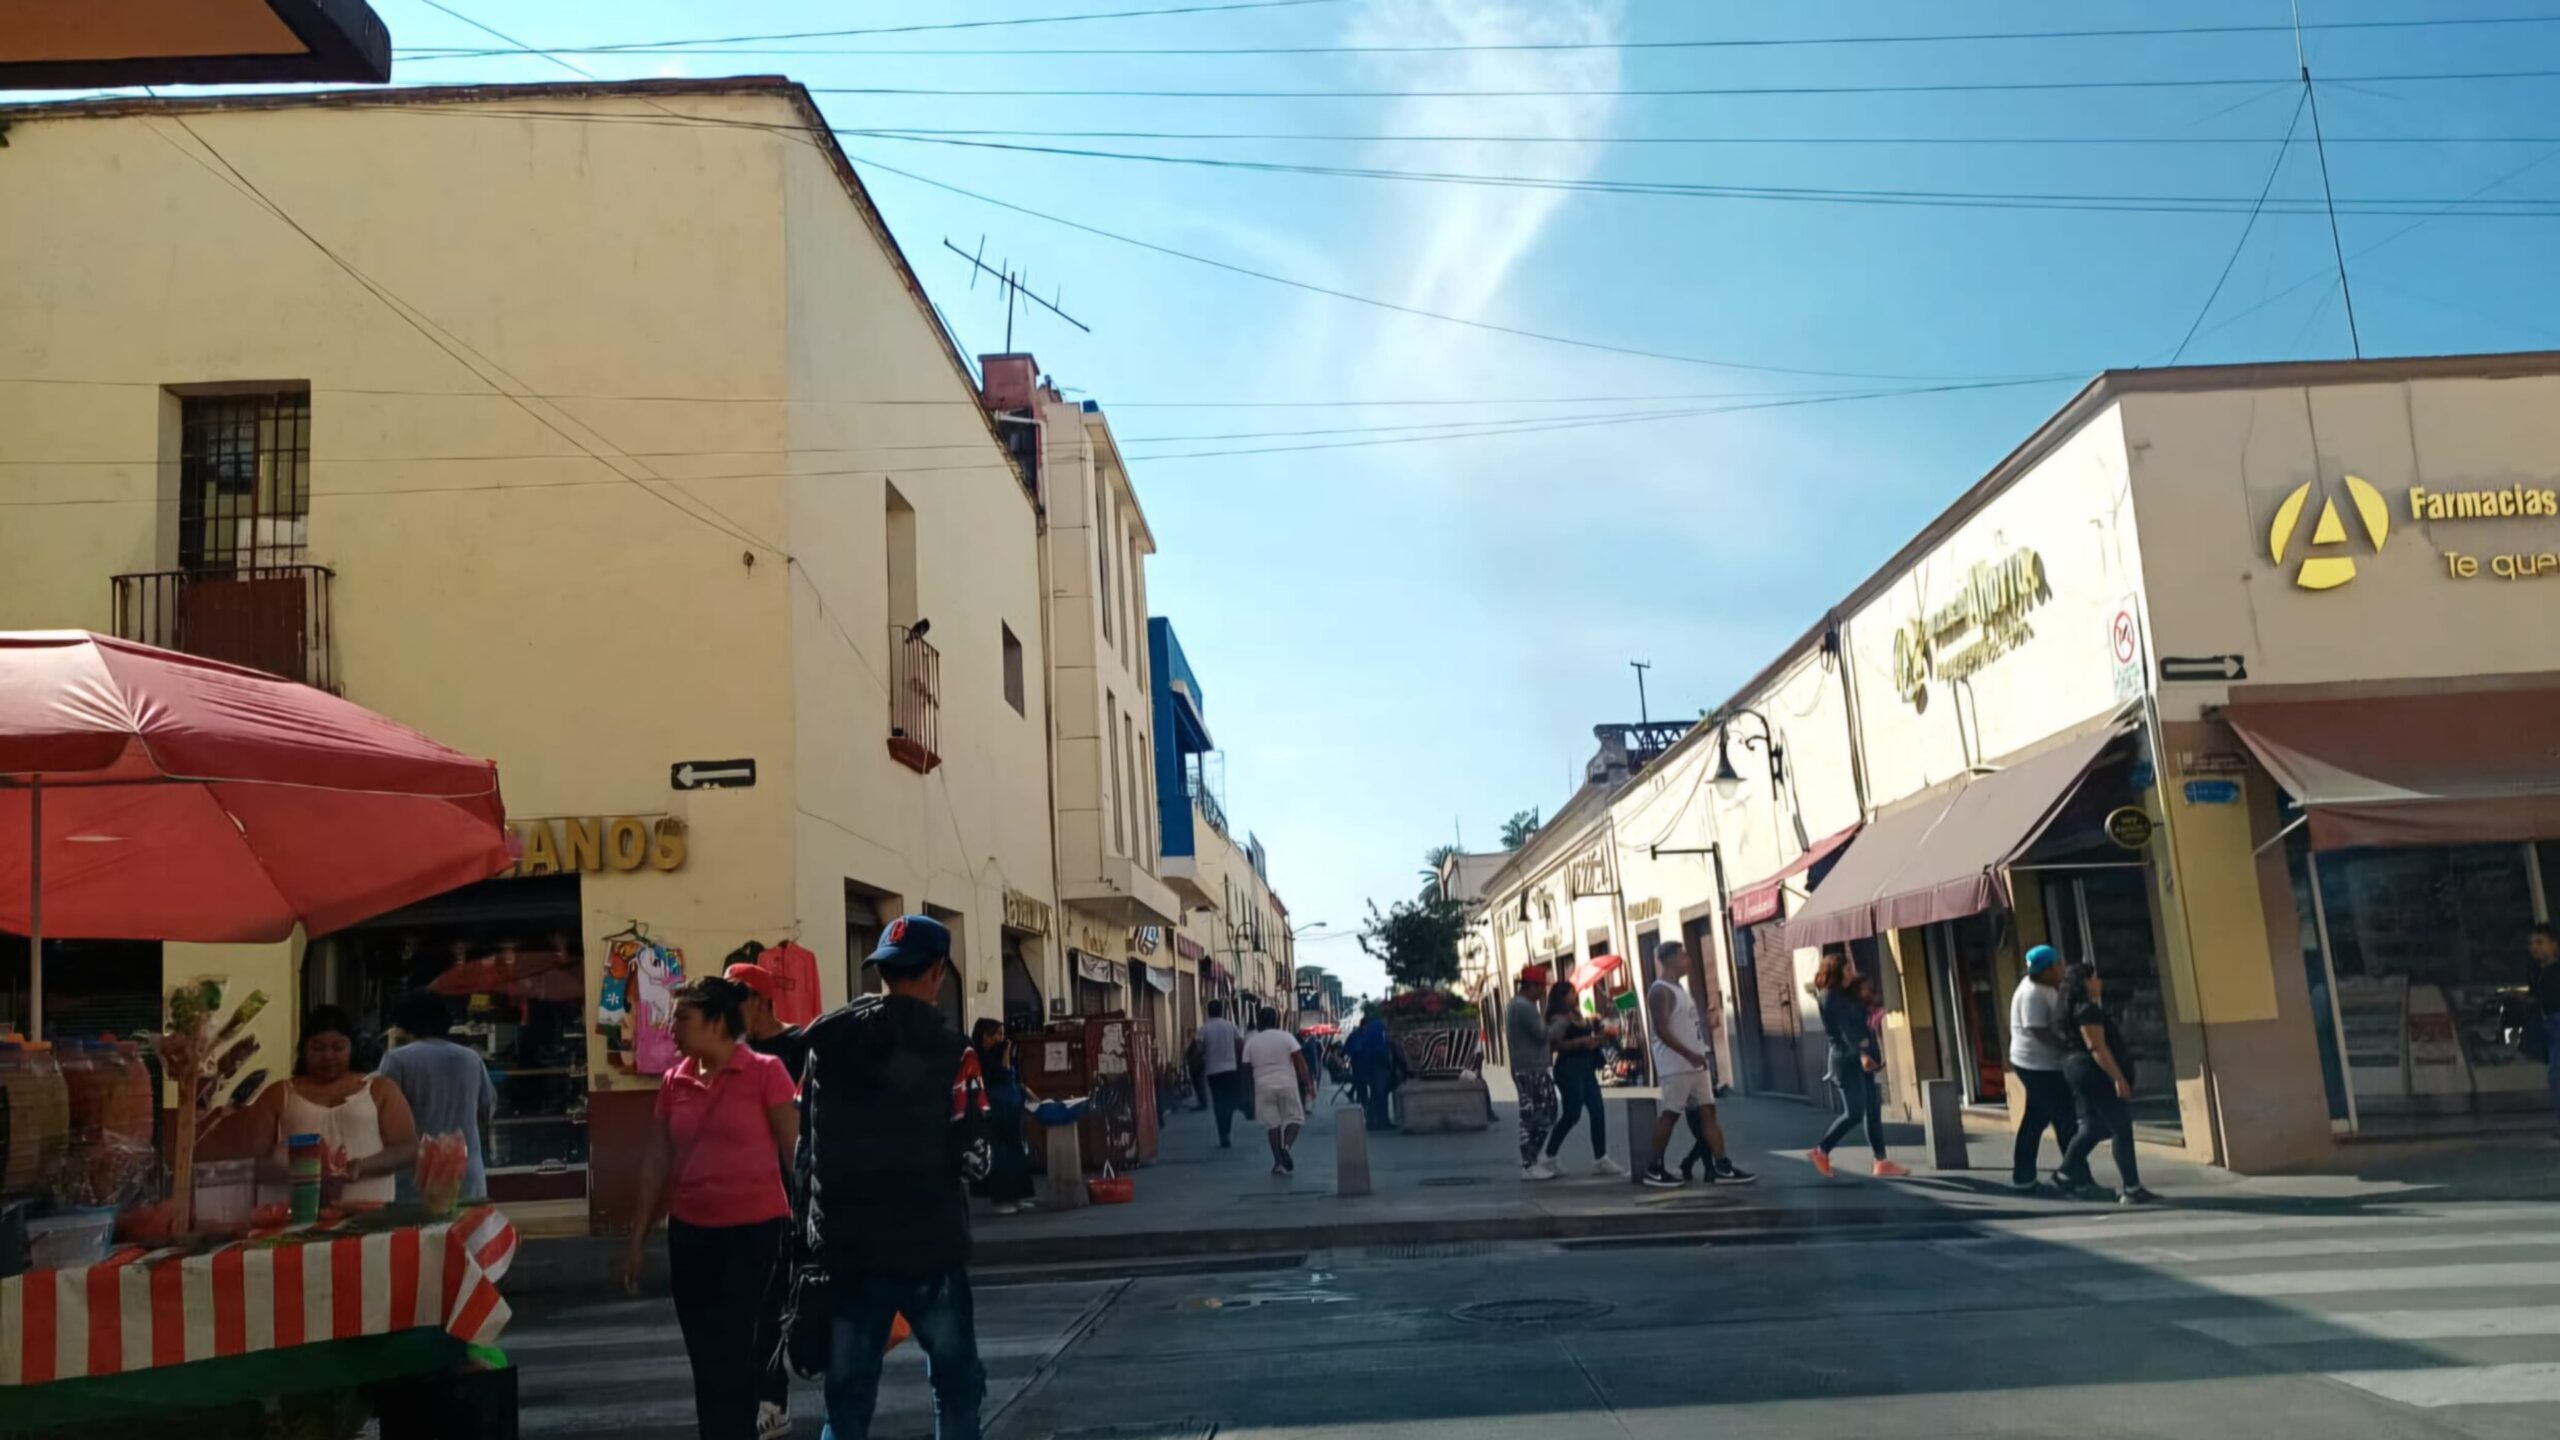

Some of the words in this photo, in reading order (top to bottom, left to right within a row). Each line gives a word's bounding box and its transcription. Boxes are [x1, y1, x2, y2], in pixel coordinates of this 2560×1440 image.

[2409, 483, 2558, 519] Farmacias
[2444, 552, 2478, 578] Te
[2492, 552, 2560, 580] que
